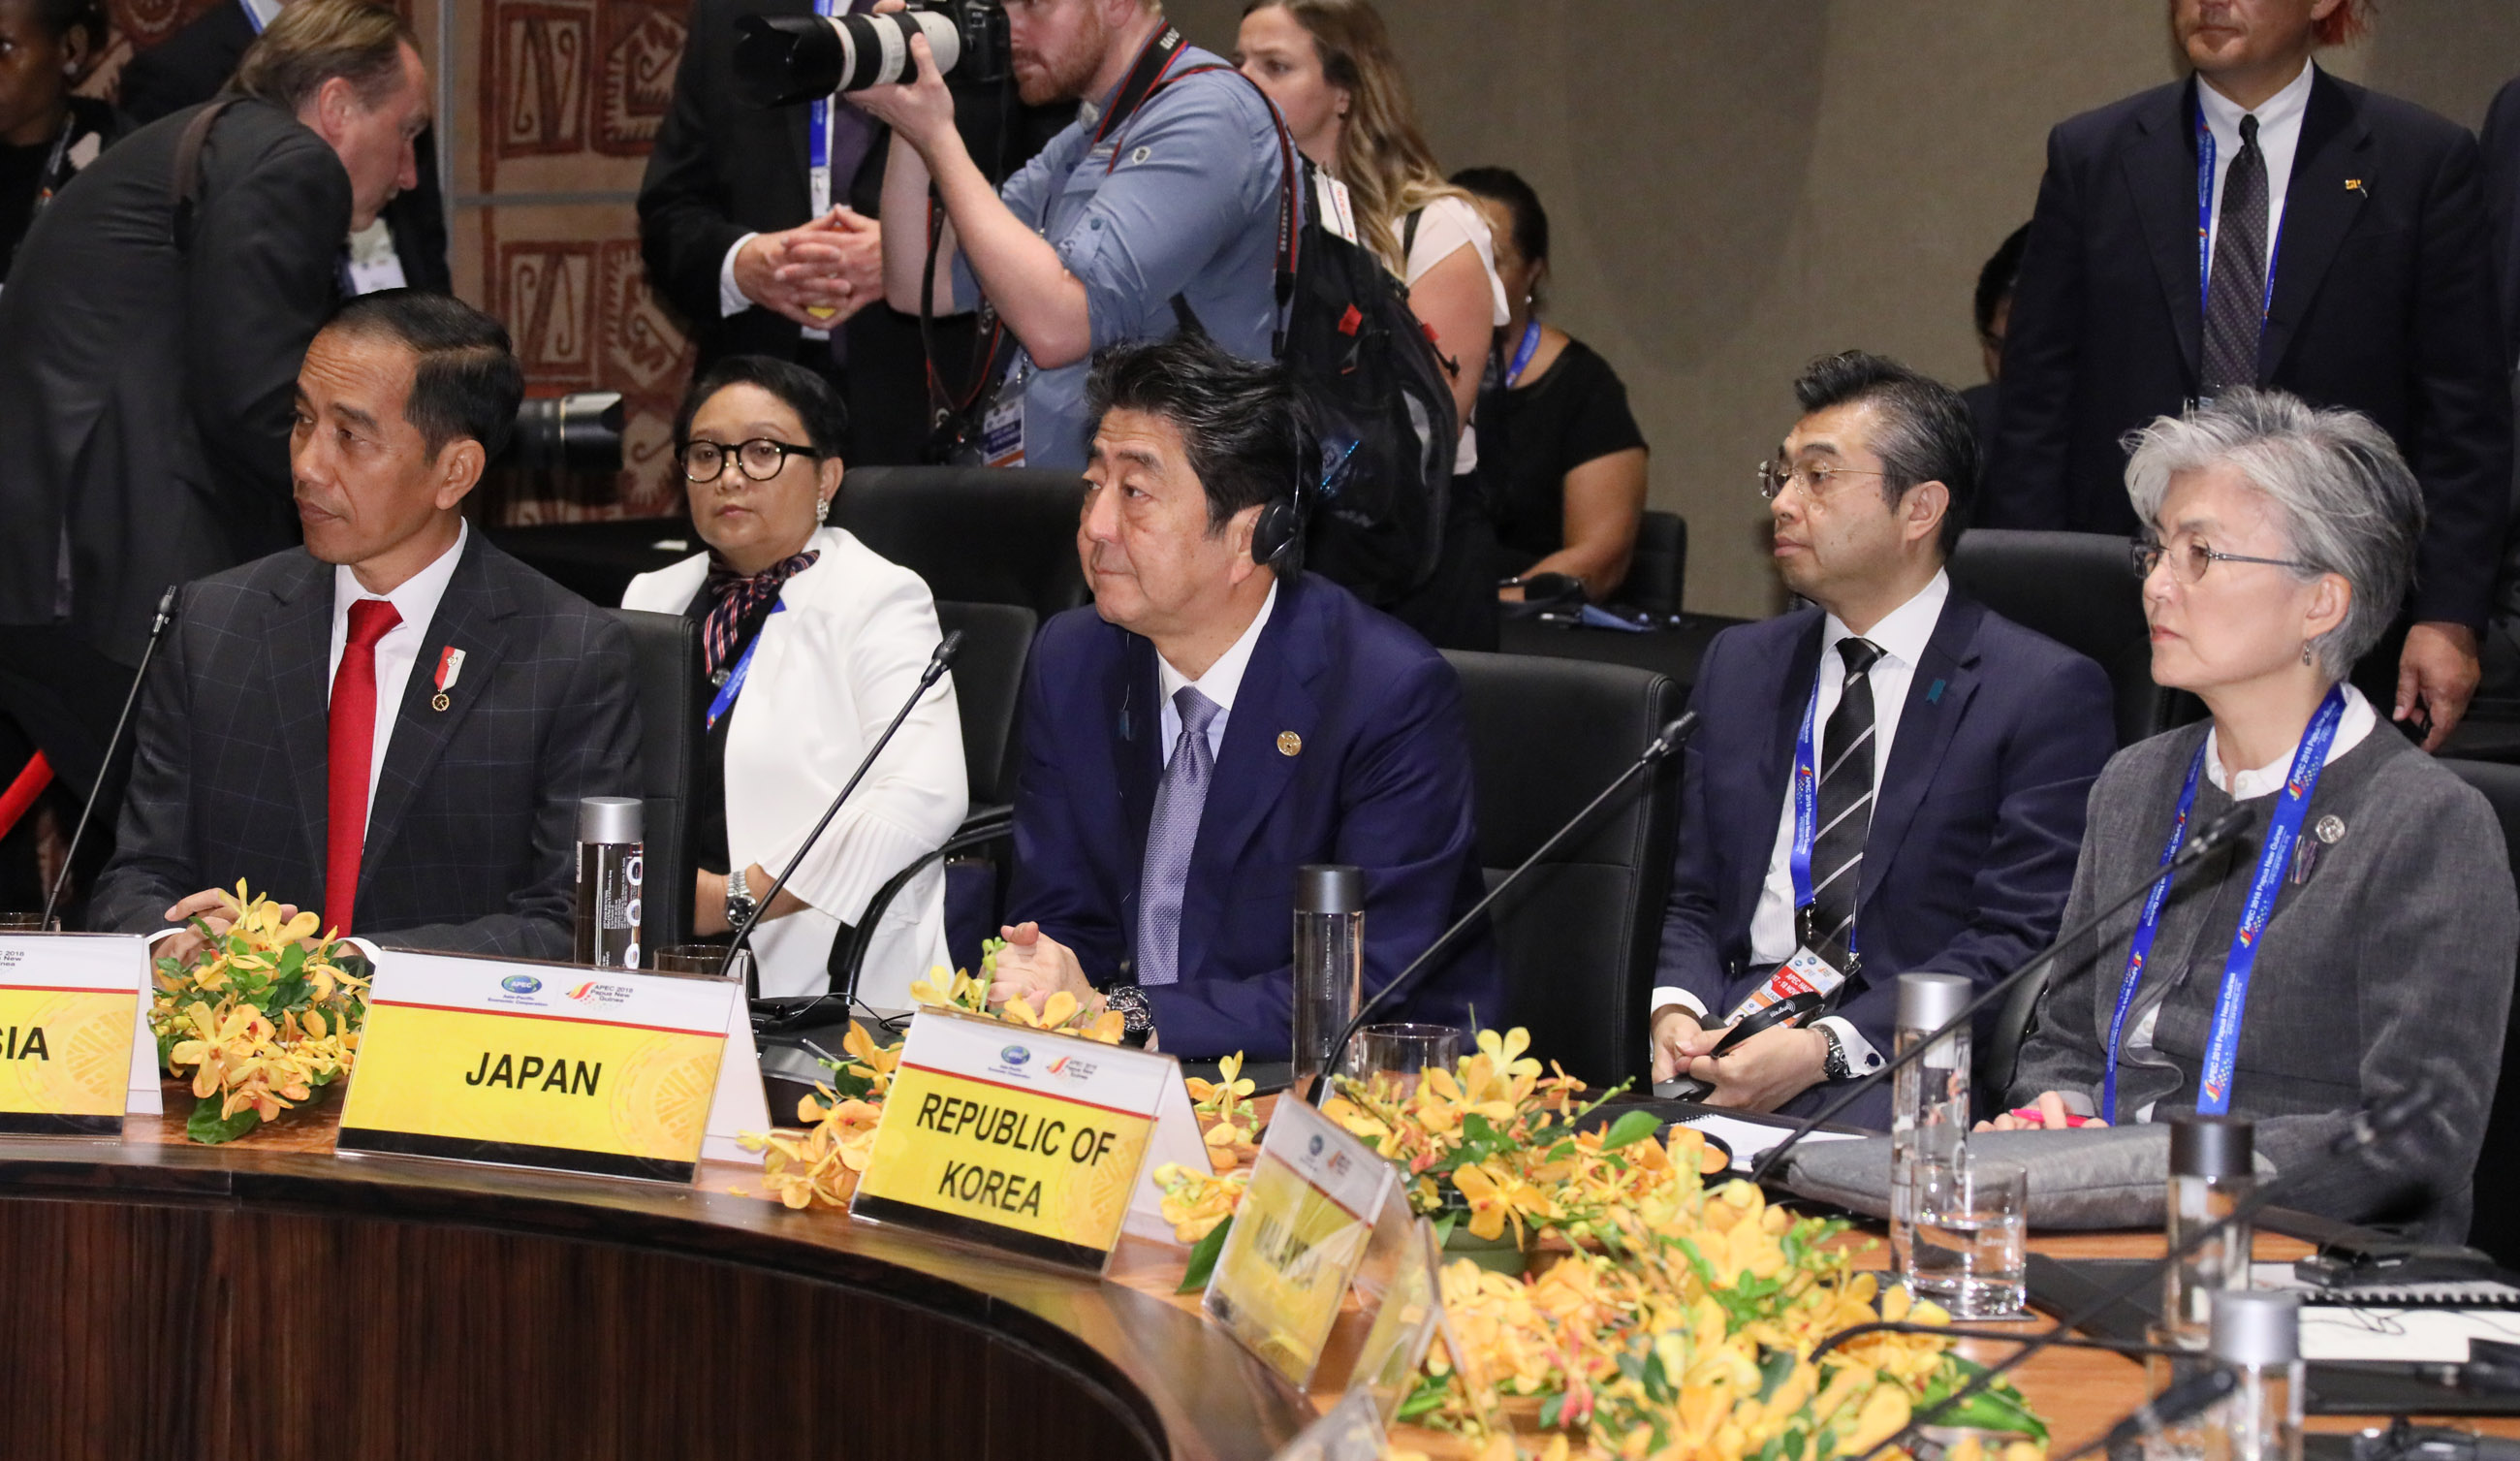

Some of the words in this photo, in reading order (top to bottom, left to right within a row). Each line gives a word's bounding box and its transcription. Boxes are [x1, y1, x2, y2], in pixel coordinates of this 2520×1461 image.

[2300, 746, 2313, 763] 2018
[2270, 825, 2284, 850] Guinea
[2264, 851, 2275, 867] New
[2256, 868, 2269, 890] Papua
[2251, 891, 2262, 908] 2018
[2244, 909, 2255, 932] APEC
[2224, 972, 2236, 1000] Guinea
[2221, 1000, 2230, 1017] New
[2216, 1018, 2227, 1041] Papua
[2212, 1042, 2222, 1061] 2018
[465, 1052, 602, 1096] JAPAN
[2208, 1062, 2219, 1085] APEC
[917, 1093, 1066, 1156] REPUBLIC
[1070, 1127, 1116, 1165] OF
[937, 1160, 1042, 1218] KOREA
